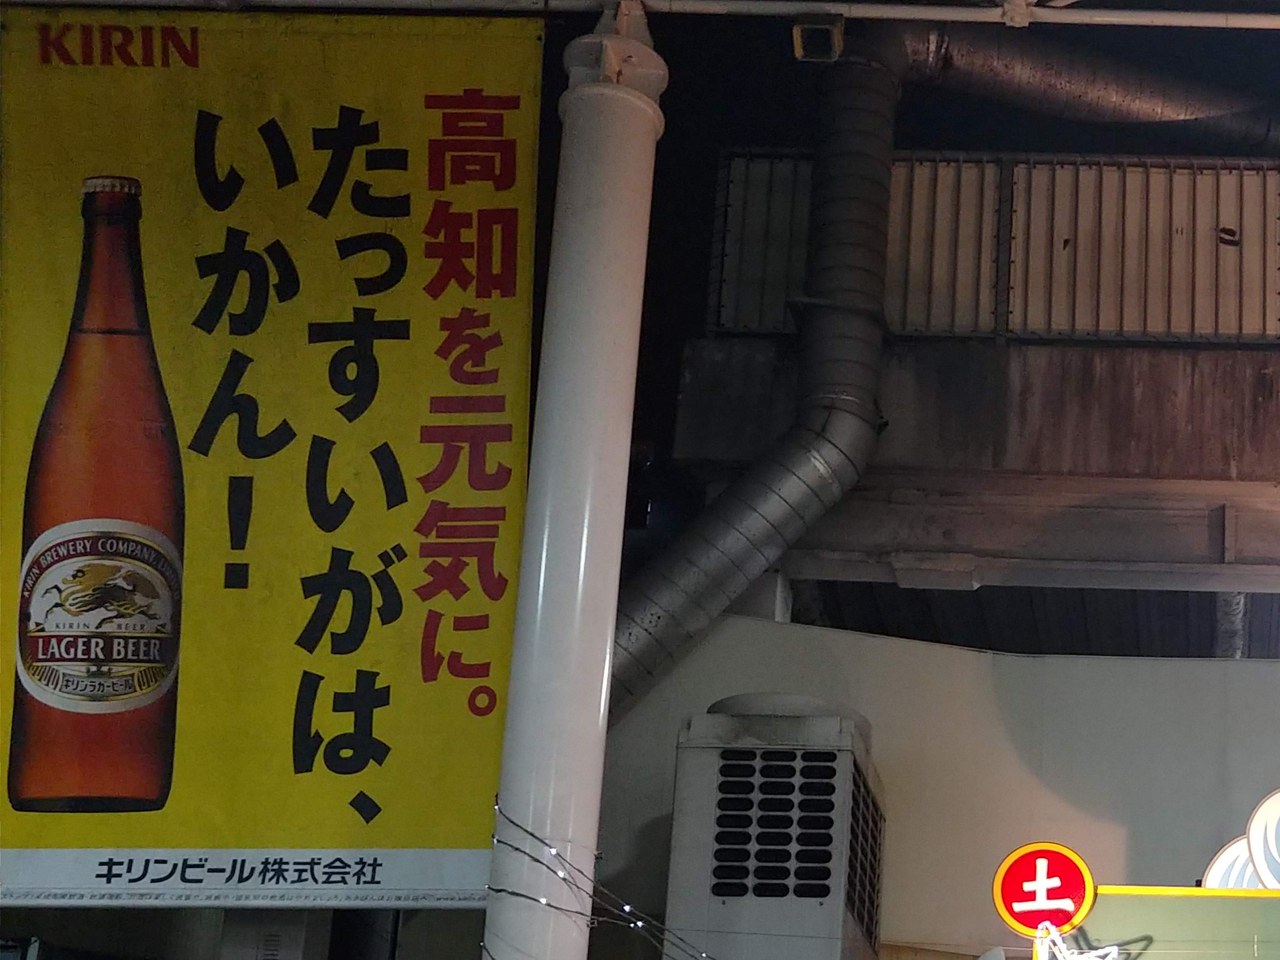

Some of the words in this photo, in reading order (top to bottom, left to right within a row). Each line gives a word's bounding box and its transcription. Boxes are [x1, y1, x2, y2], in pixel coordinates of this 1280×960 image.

[38, 23, 200, 68] KIRIN
[188, 109, 300, 589] いかん！
[414, 88, 521, 717] 高知を元気に。
[292, 105, 411, 825] たっすいがは、
[23, 567, 41, 599] KIRIN
[40, 540, 93, 568] BREWERY
[37, 637, 105, 660] LAGER
[112, 638, 161, 661] BEER
[55, 622, 90, 630] KIRIN
[95, 857, 384, 886] キリンビール株式会社
[1011, 857, 1075, 912] 土
